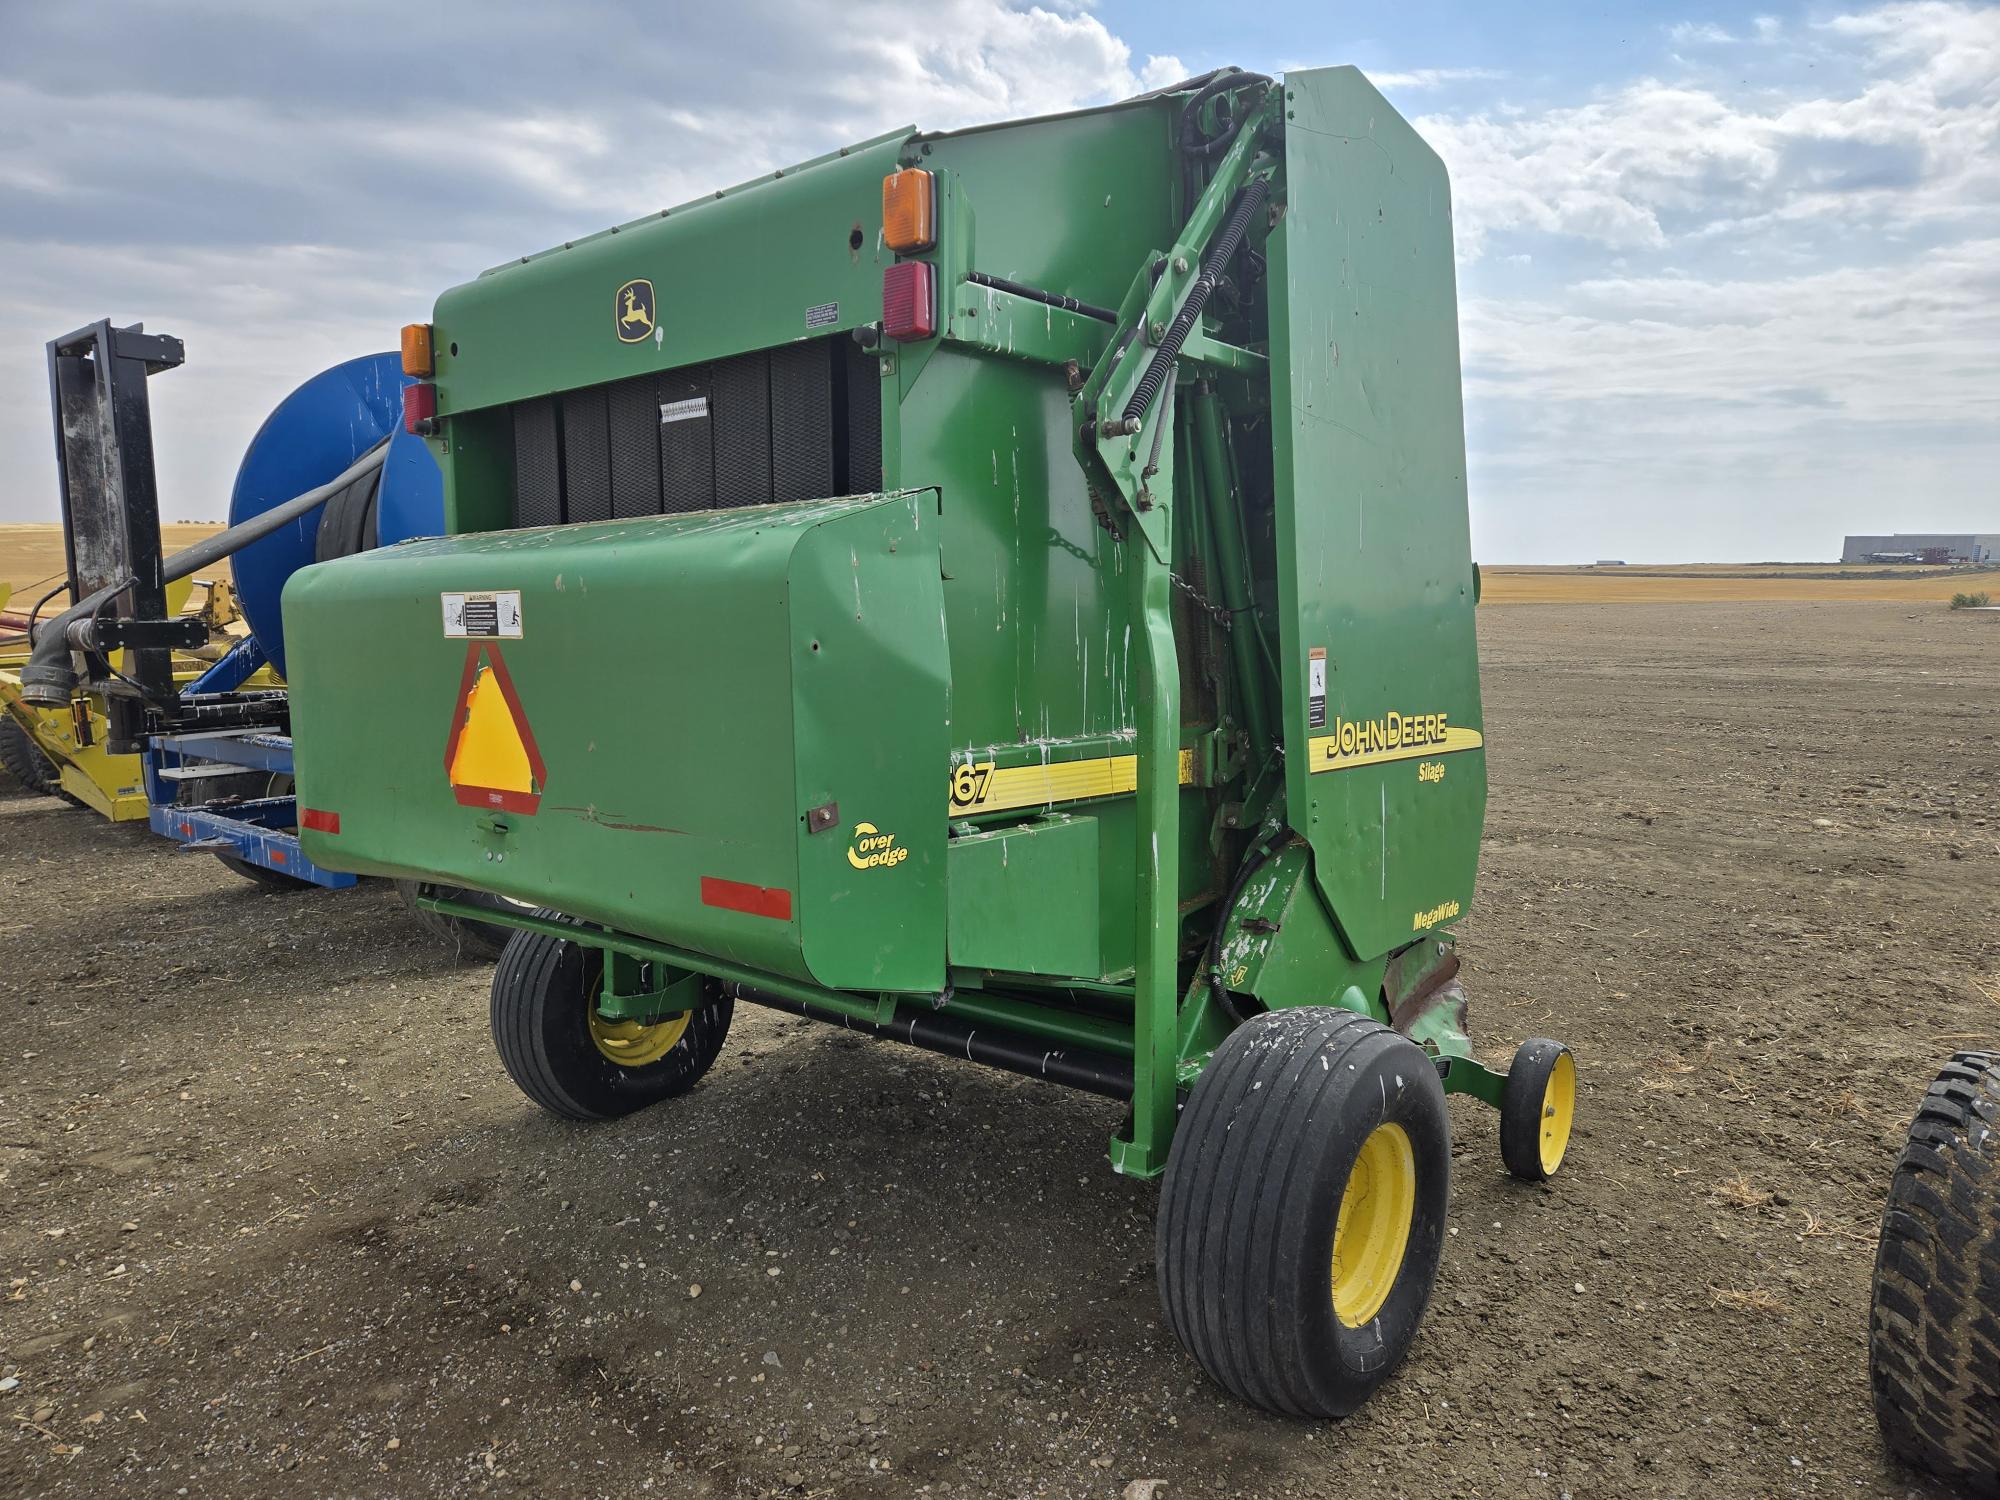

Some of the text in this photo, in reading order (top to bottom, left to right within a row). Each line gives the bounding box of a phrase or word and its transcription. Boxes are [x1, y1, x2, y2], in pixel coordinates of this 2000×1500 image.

[949, 762, 996, 805] 67
[1418, 762, 1446, 783] Silage
[1413, 900, 1460, 931] MegaWide
